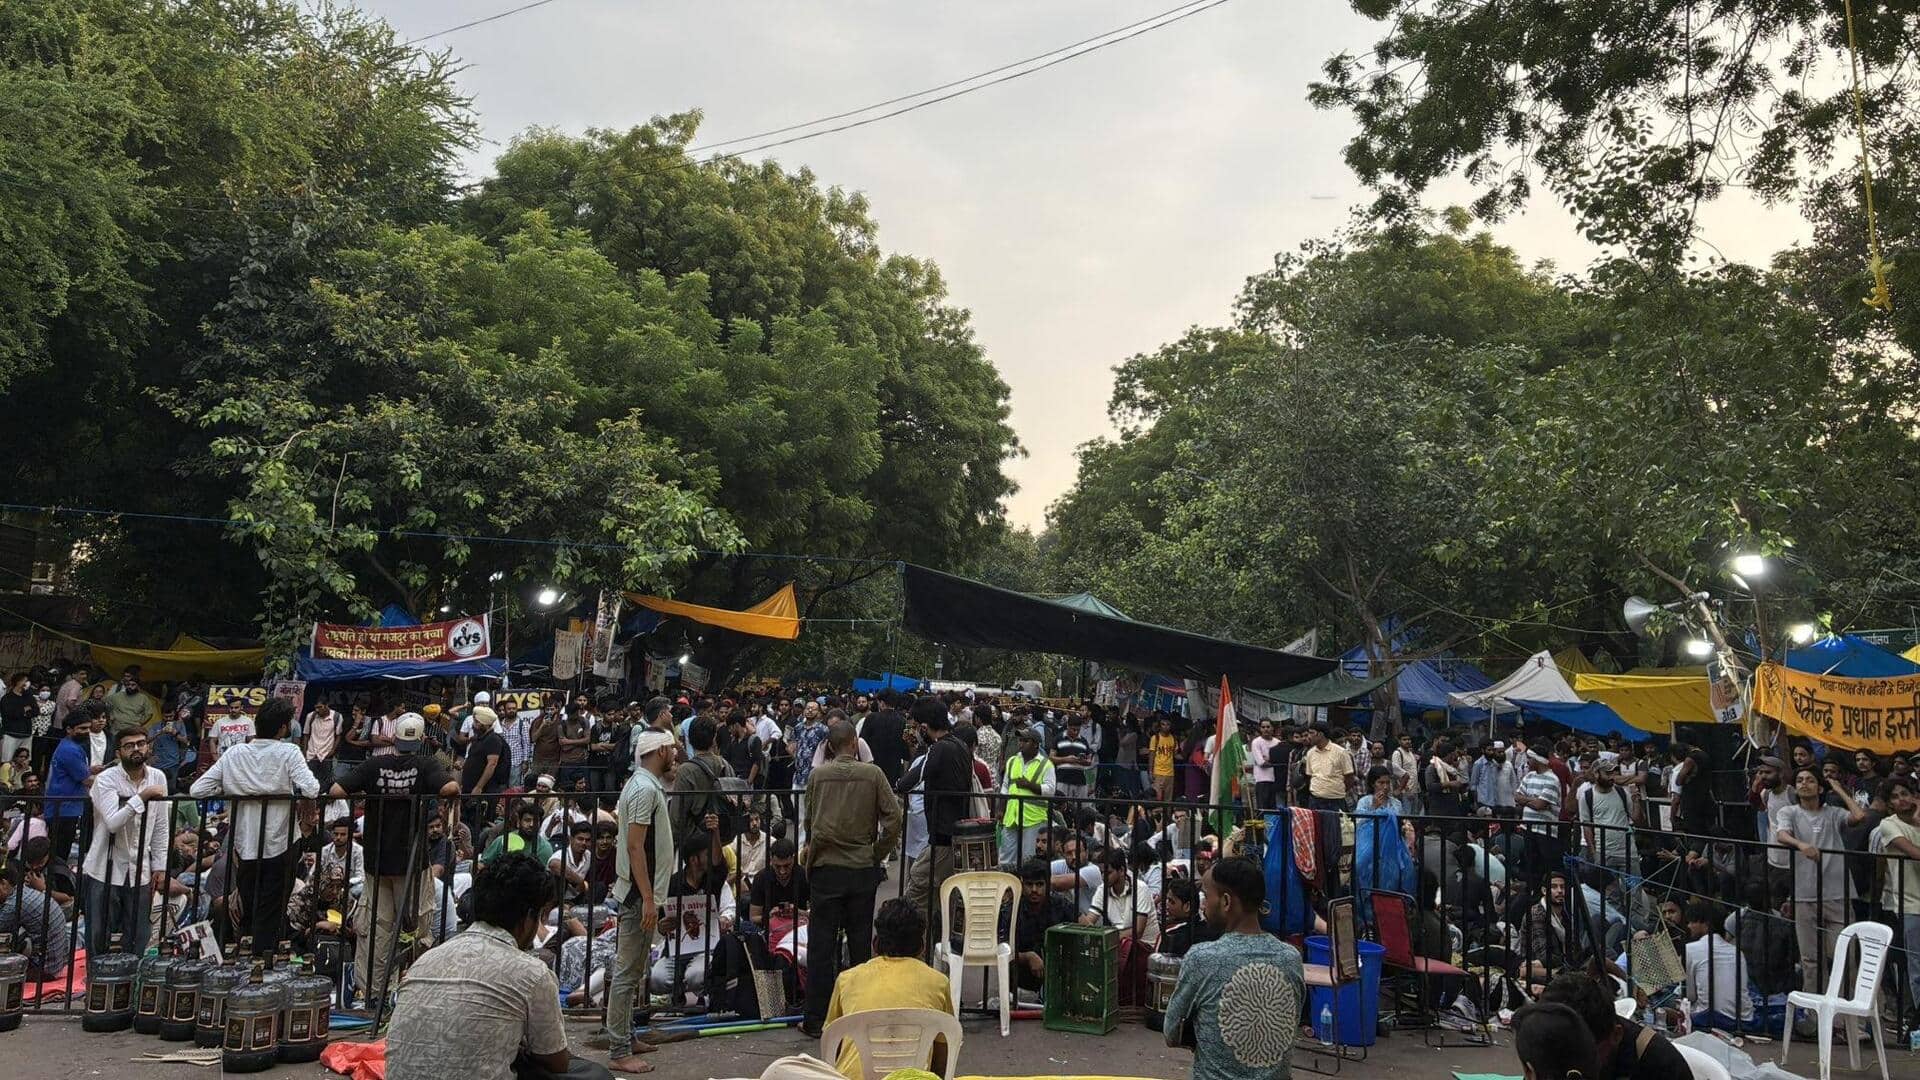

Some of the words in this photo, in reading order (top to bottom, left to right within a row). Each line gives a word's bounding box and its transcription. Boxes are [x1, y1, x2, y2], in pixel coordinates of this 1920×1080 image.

[453, 632, 481, 648] KYS
[380, 648, 410, 660] समान
[207, 687, 267, 706] KYS
[1840, 704, 1883, 740] प्रधान
[379, 767, 418, 779] YOUNG
